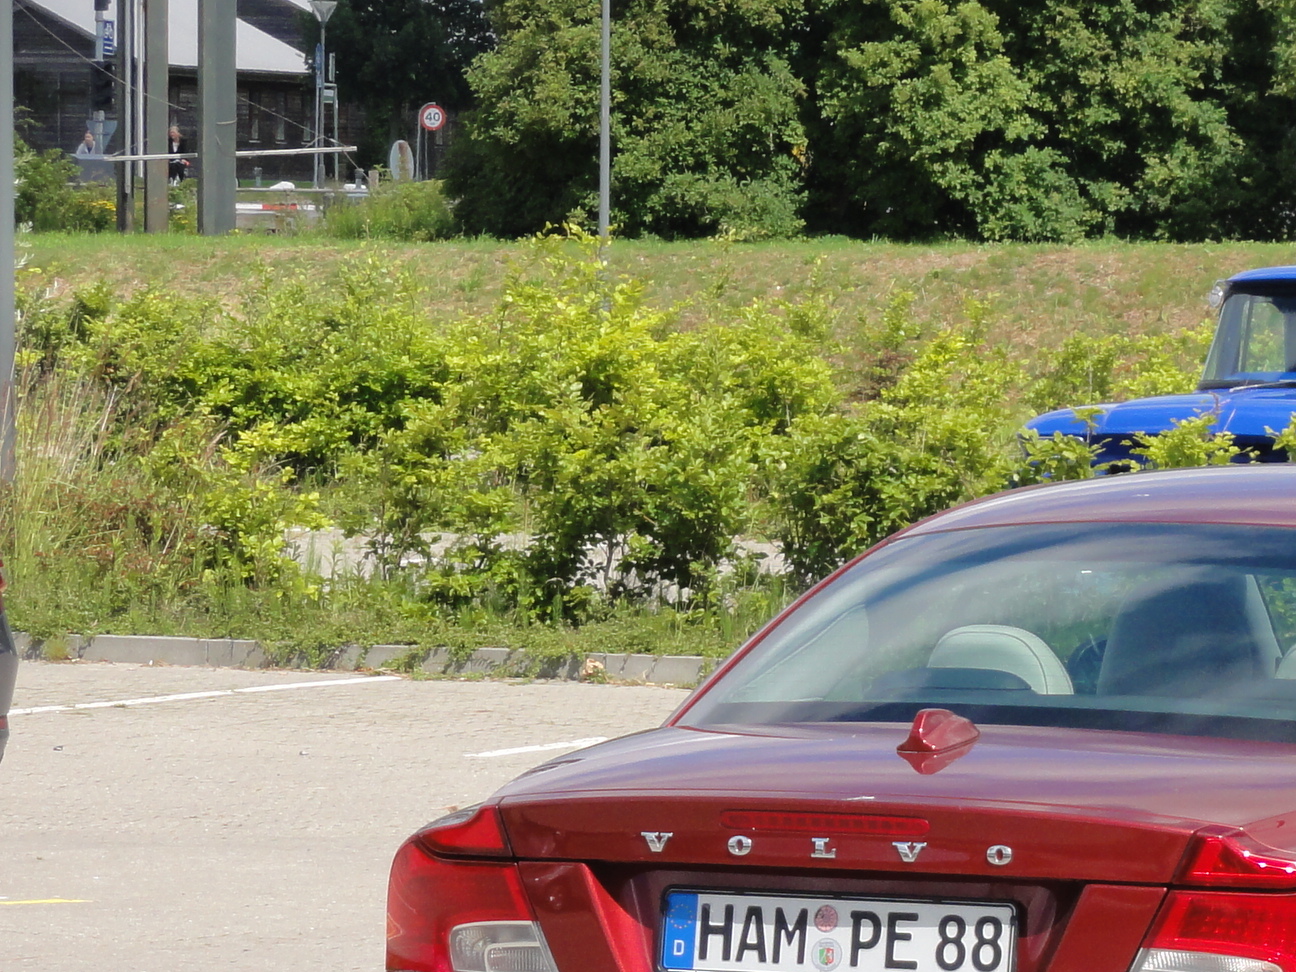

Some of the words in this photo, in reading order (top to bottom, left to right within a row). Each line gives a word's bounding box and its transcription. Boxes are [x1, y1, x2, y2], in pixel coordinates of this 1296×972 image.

[425, 112, 440, 121] 40
[641, 831, 1013, 866] VOLVO
[673, 938, 685, 956] D
[699, 904, 808, 965] HAM
[849, 910, 919, 971] PE
[935, 915, 1003, 972] 88
